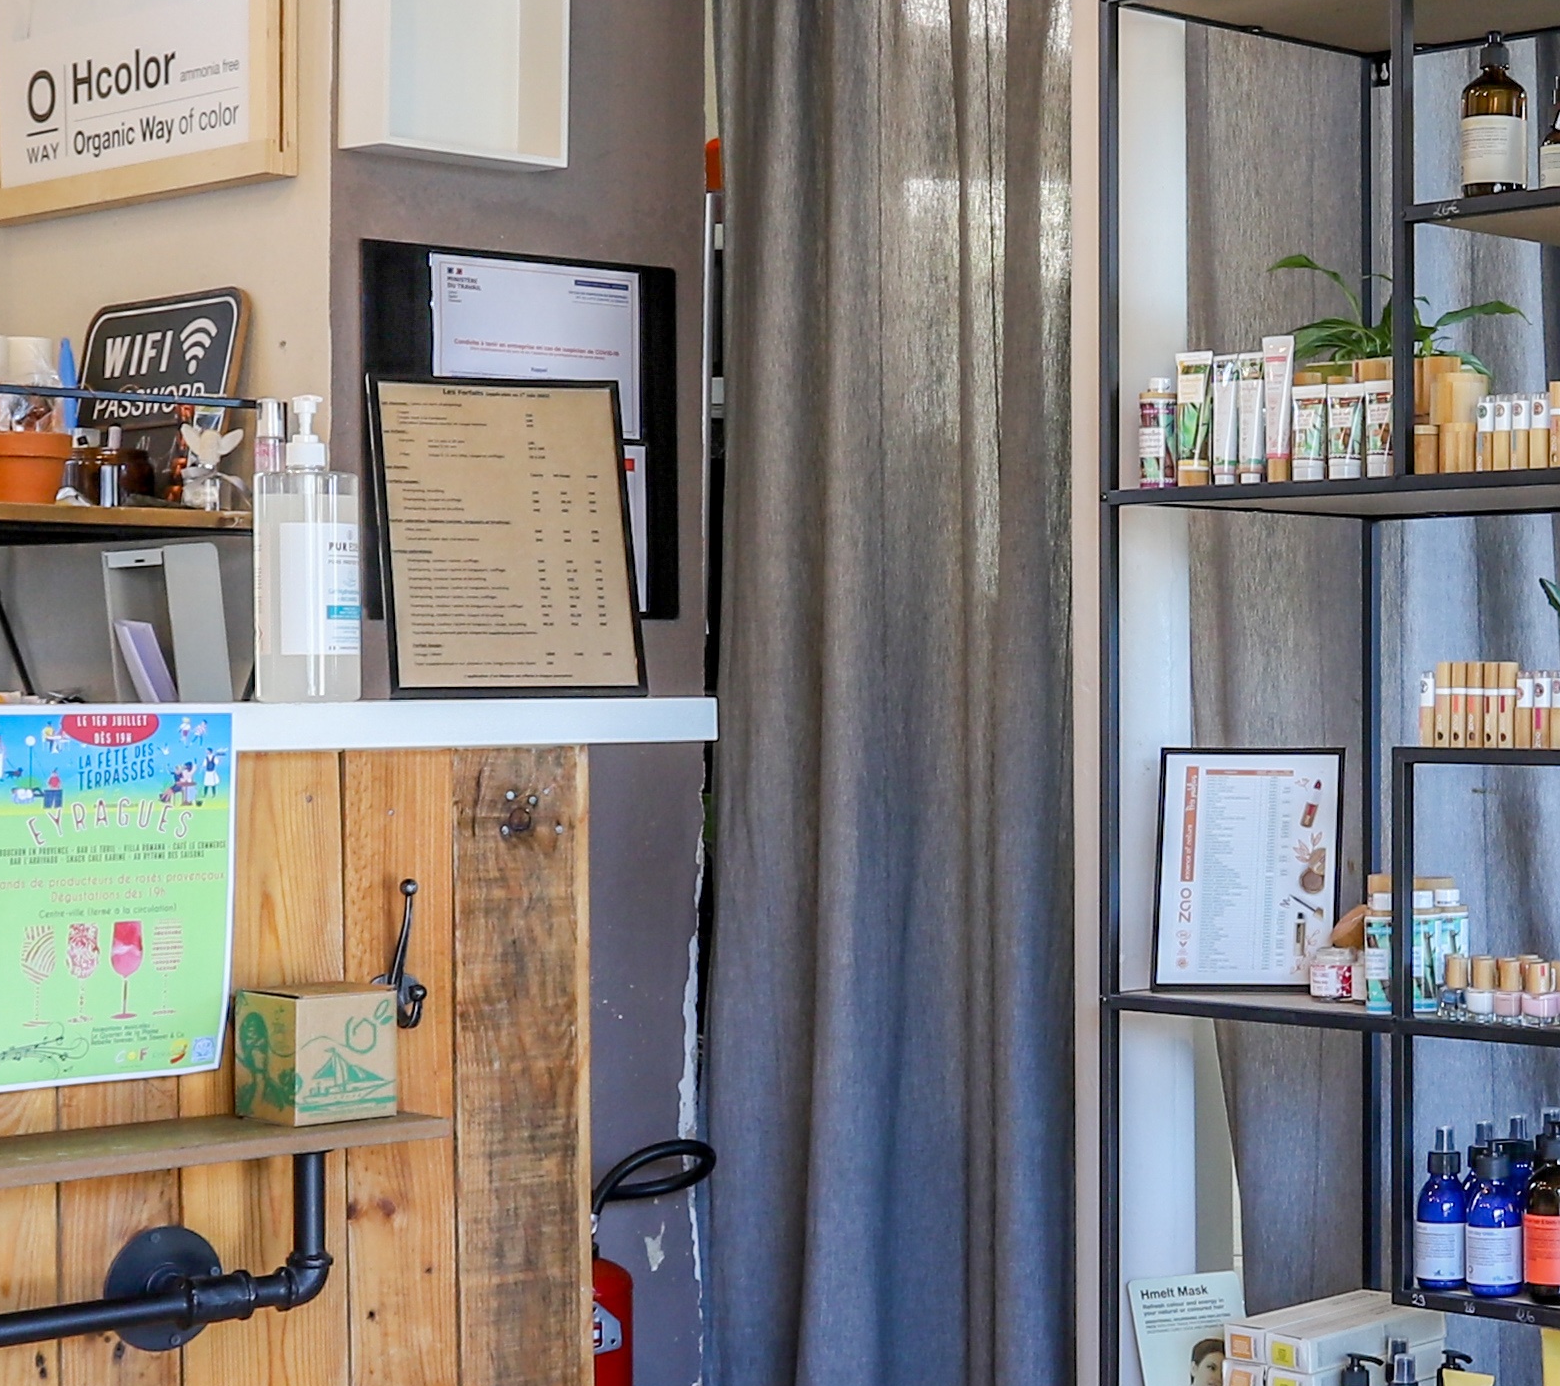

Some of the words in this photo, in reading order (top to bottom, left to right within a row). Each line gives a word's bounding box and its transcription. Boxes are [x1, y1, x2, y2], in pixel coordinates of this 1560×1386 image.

[73, 49, 175, 104] Hcolor
[180, 62, 220, 82] ammonia
[222, 58, 239, 73] free
[27, 70, 55, 123] O
[74, 122, 135, 157] Organic
[140, 117, 174, 143] Way
[179, 108, 195, 135] of
[199, 102, 239, 131] color
[27, 143, 59, 163] WAY
[104, 330, 173, 378] WIFI
[77, 716, 87, 727] LE
[92, 716, 108, 727] 1ER
[112, 715, 147, 727] JUILLET
[94, 732, 113, 744] DÈS
[116, 733, 132, 744] 19H
[79, 756, 92, 769] LA
[98, 747, 127, 768] FÊTE
[135, 743, 154, 757] DES
[78, 758, 155, 790] TERRASSES
[27, 798, 192, 845] EYRAGUES
[31, 878, 44, 888] de
[50, 876, 115, 888] producteurs
[118, 875, 131, 884] de
[51, 889, 120, 904] Dégustations
[149, 887, 166, 897] 19h
[1141, 1288, 1175, 1300] Hmelt
[1178, 1285, 1208, 1296] Mask
